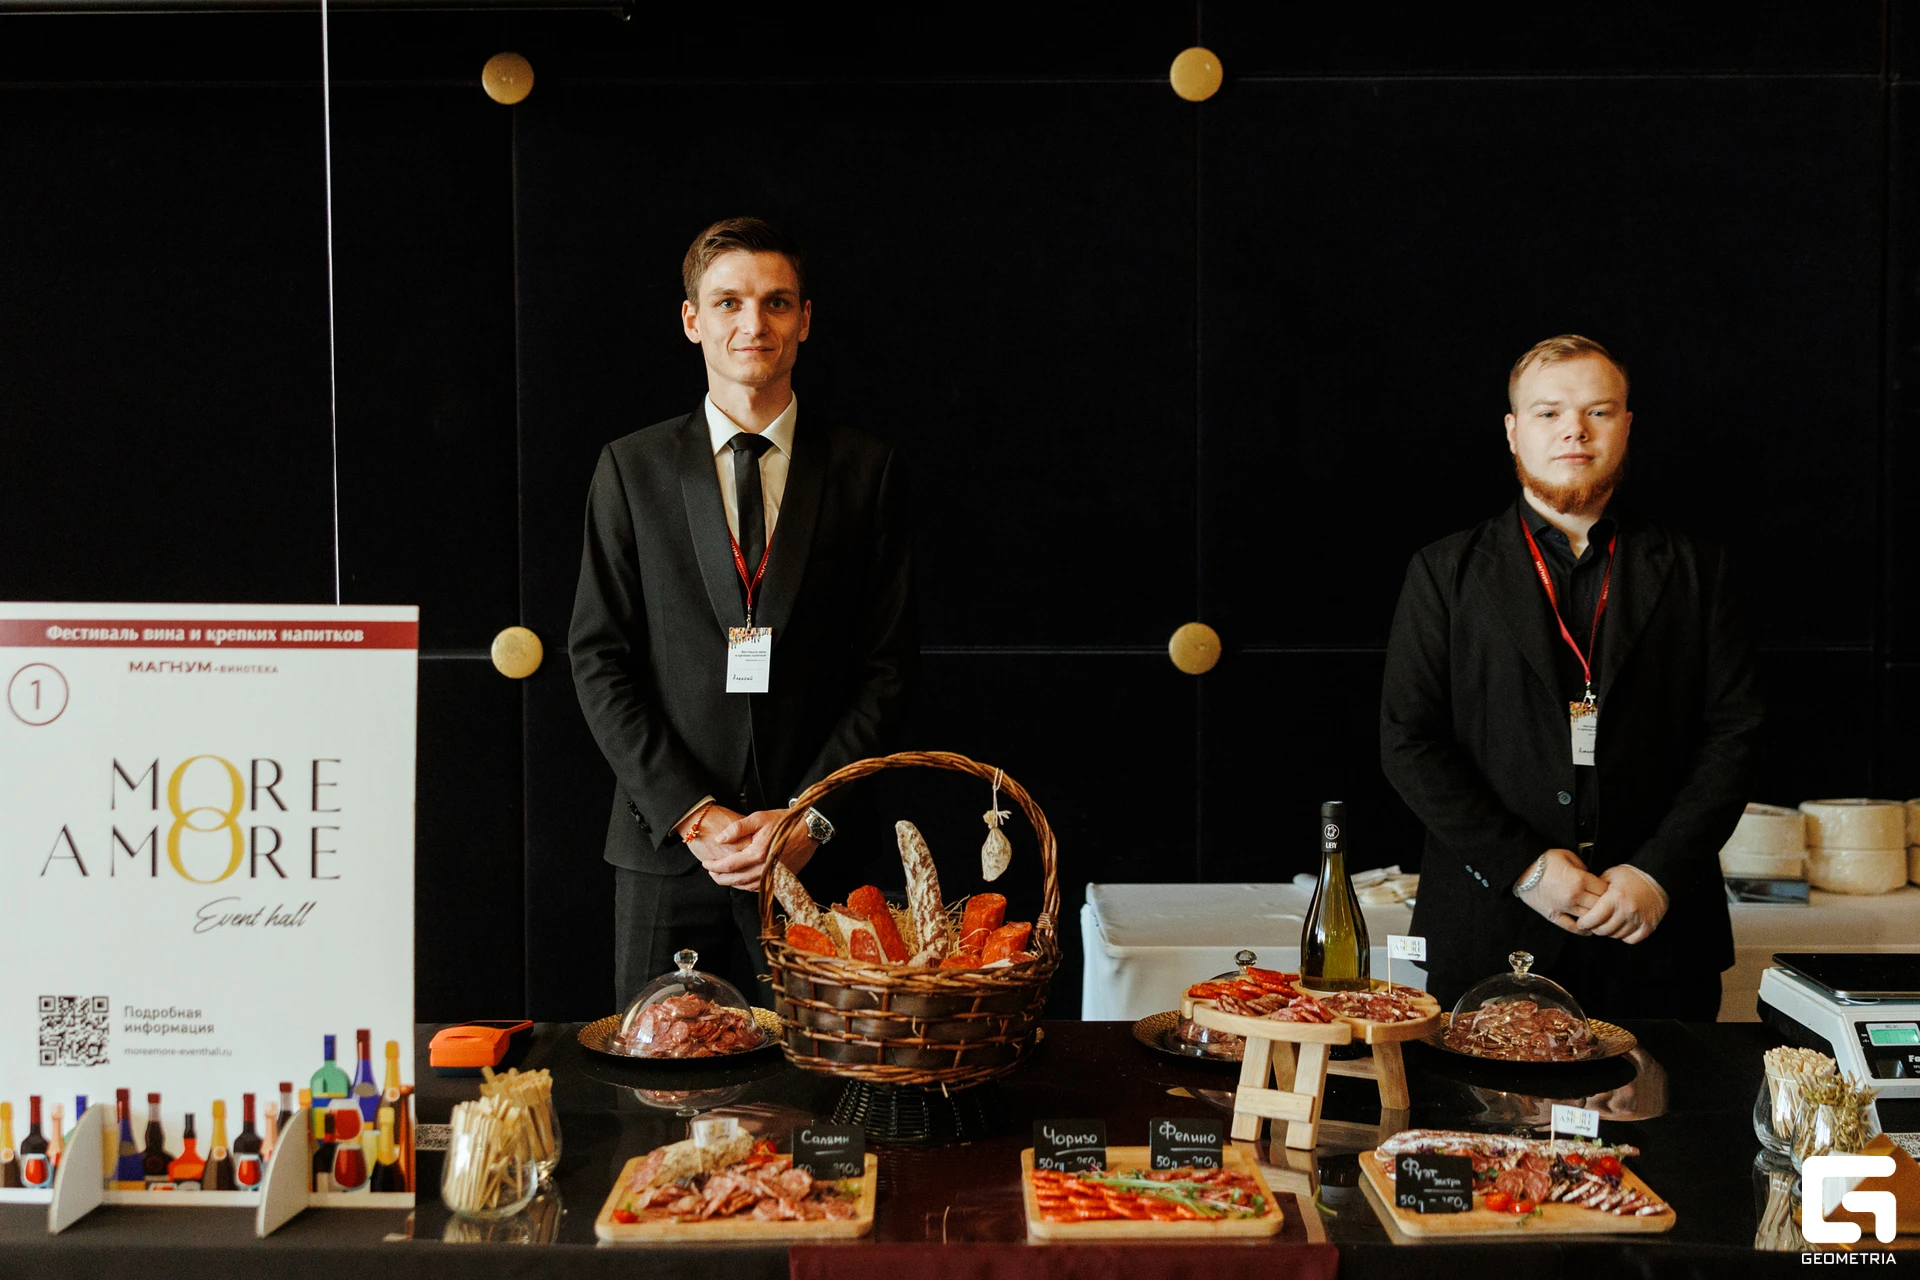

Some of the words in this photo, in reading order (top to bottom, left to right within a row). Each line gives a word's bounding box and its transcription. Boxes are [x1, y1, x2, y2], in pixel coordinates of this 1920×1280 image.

[45, 625, 140, 642] Фестиваль
[142, 628, 186, 642] вина
[188, 628, 202, 642] и
[205, 628, 278, 646] крепких
[280, 628, 365, 643] напитков
[30, 679, 41, 711] 1
[111, 754, 342, 832] MORE
[39, 806, 342, 885] AMORE
[193, 896, 263, 934] Event
[264, 900, 318, 928] hall
[124, 1005, 202, 1021] Подробная
[124, 1021, 215, 1036] информация
[124, 1047, 233, 1057] moreamore-eventhall.ru
[800, 1129, 850, 1145] Салями
[1042, 1125, 1098, 1148] Чоризо
[1158, 1121, 1217, 1144] Фелино
[1401, 1156, 1439, 1181] Фуэт
